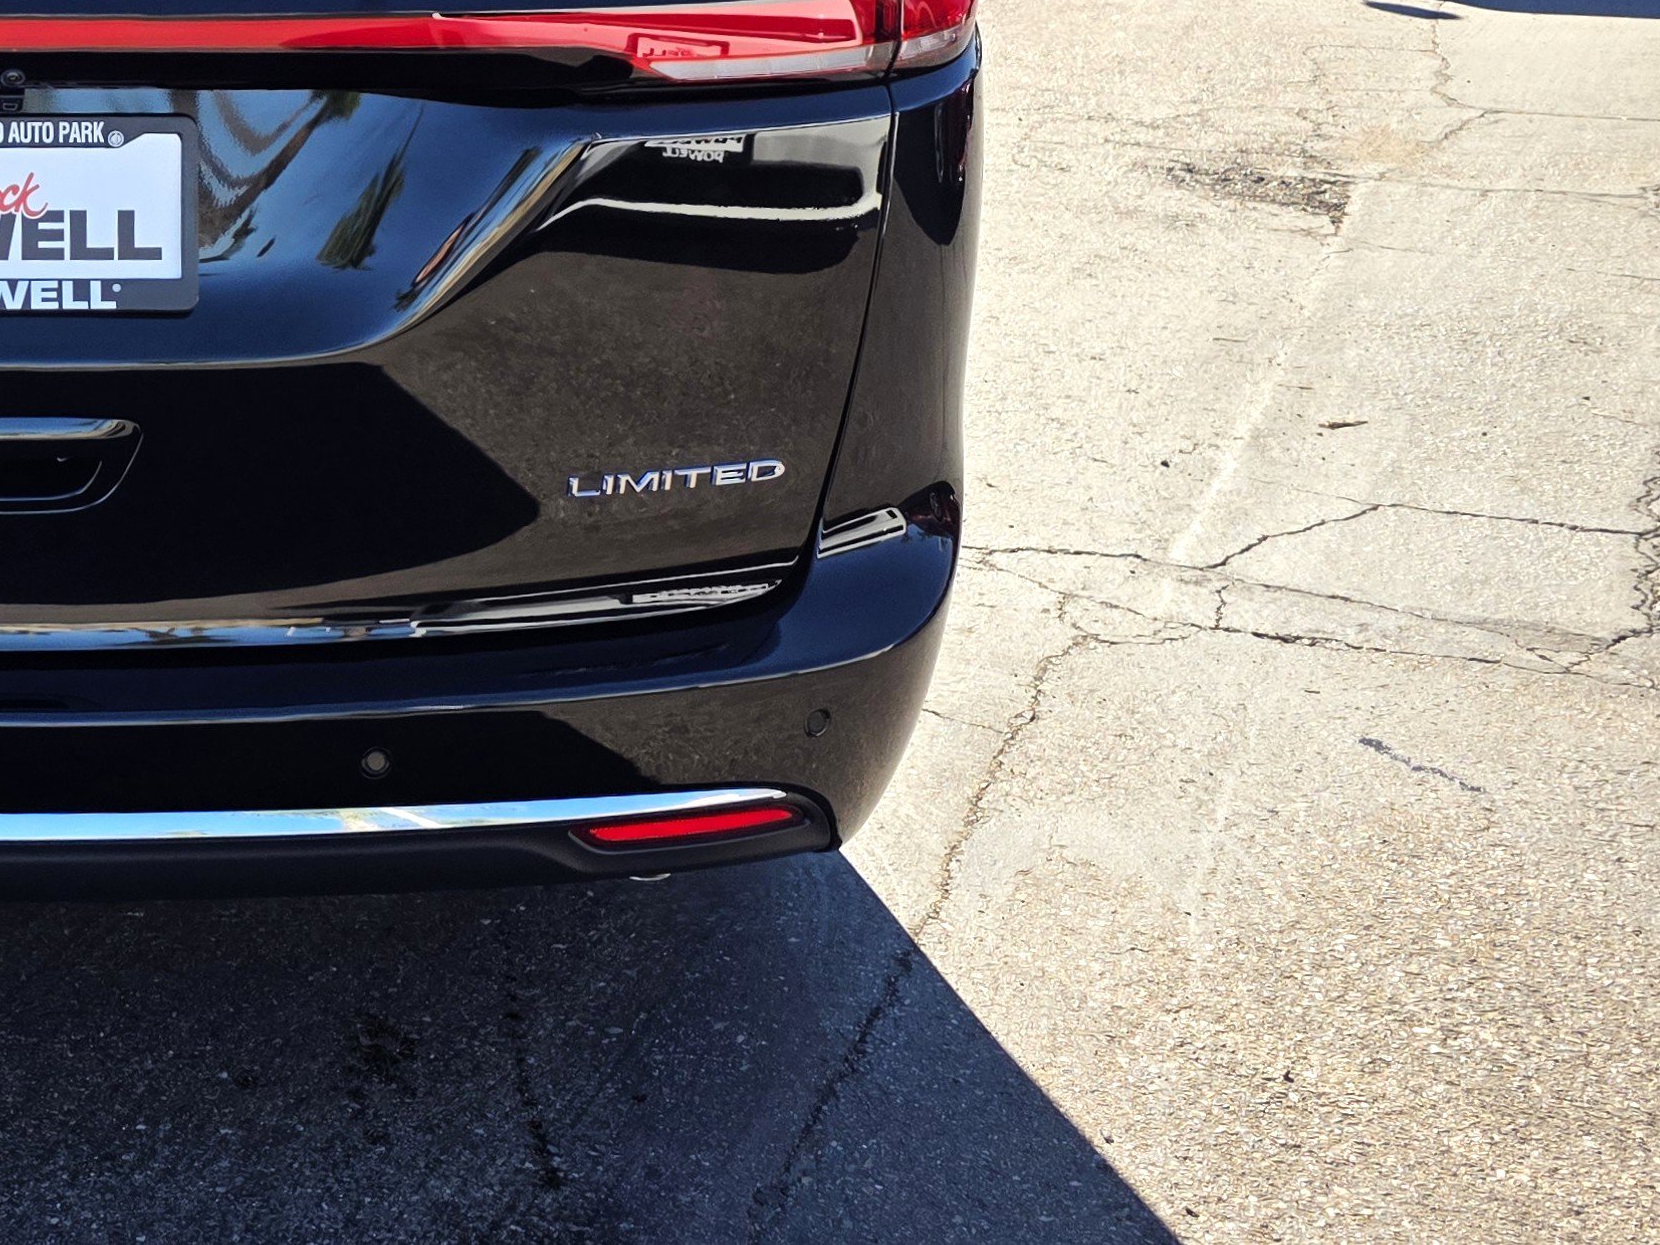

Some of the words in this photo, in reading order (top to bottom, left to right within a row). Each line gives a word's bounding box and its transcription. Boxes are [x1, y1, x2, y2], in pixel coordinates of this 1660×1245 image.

[8, 121, 55, 144] AUTO
[58, 121, 105, 143] PARK
[567, 458, 786, 497] LIMITED
